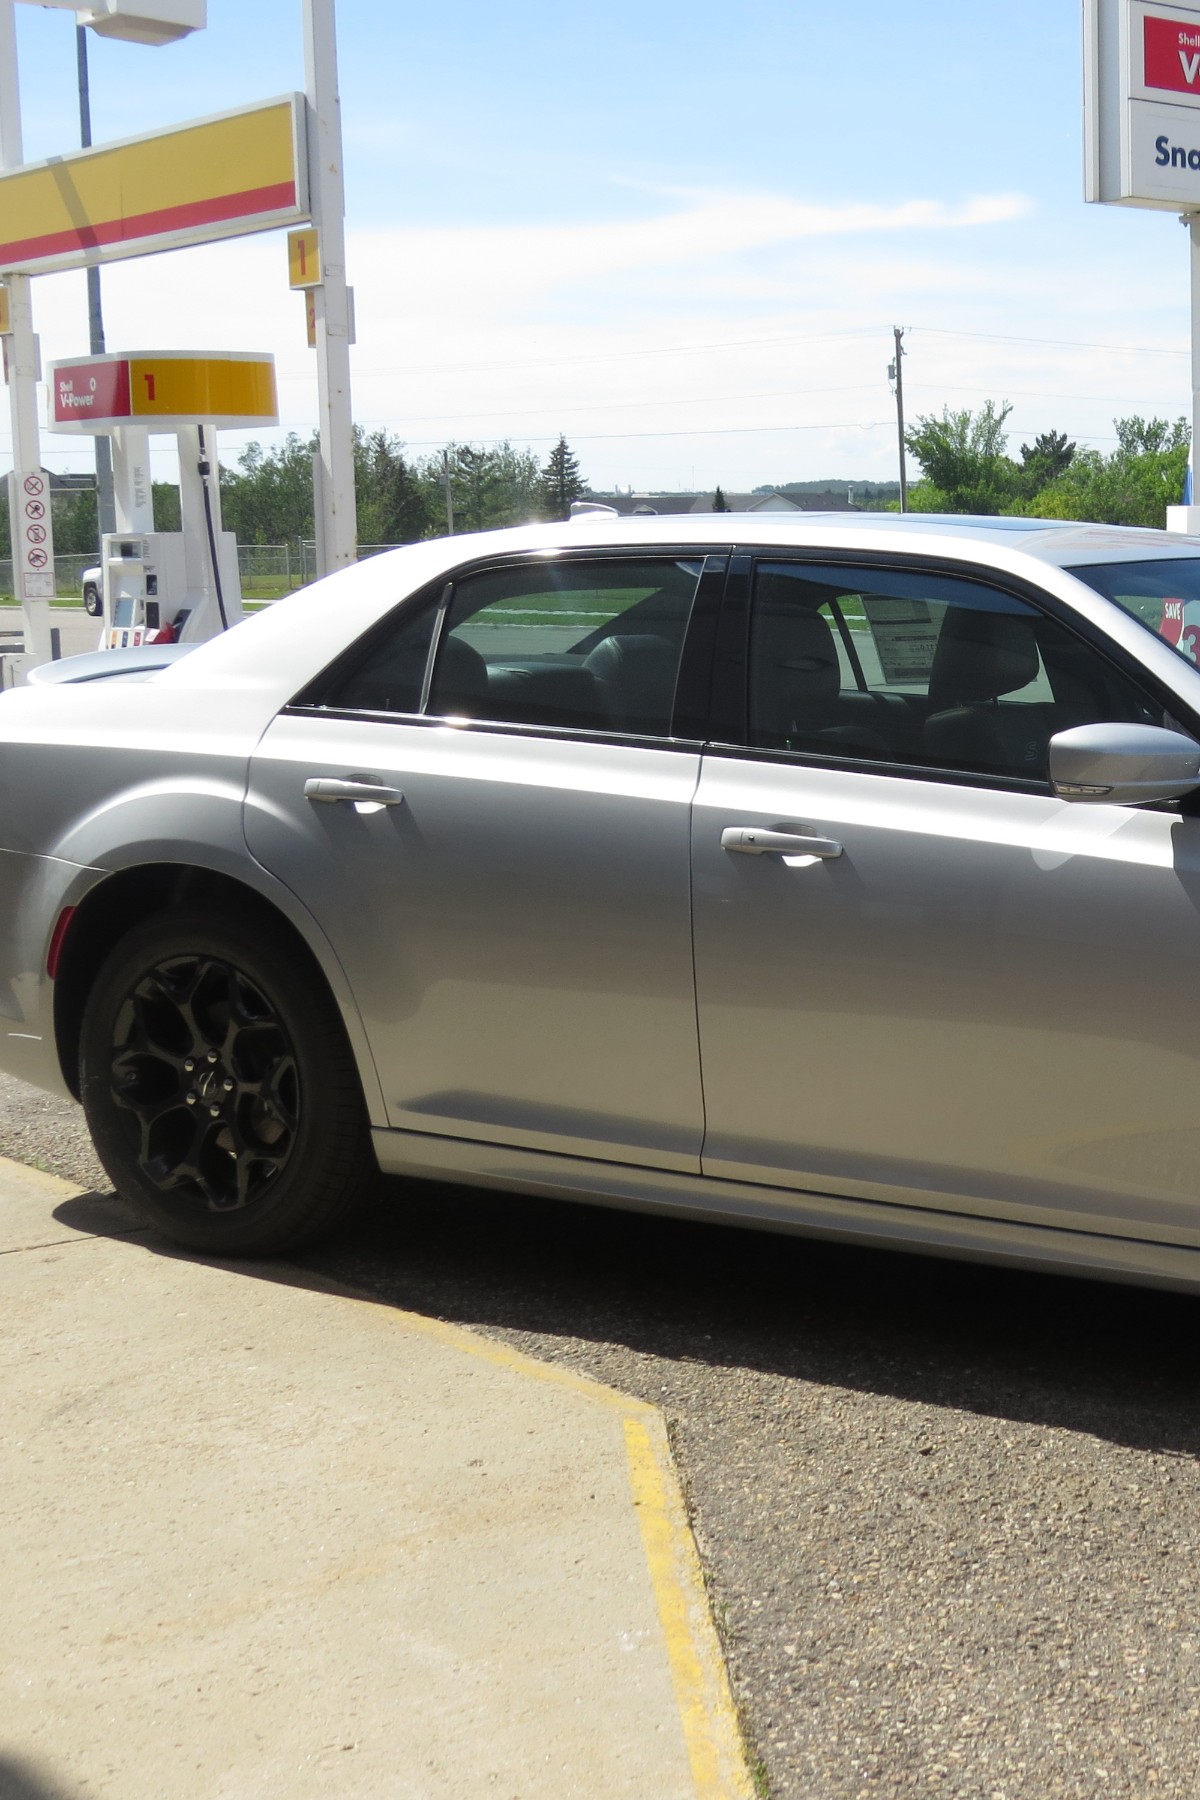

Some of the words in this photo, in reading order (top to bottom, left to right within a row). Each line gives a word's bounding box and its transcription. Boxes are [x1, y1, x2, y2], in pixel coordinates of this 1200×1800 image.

[1178, 33, 1200, 47] Shell
[297, 239, 306, 276] 1
[144, 374, 155, 400] 1
[60, 393, 94, 408] V-Power
[1164, 602, 1182, 620] SAVE
